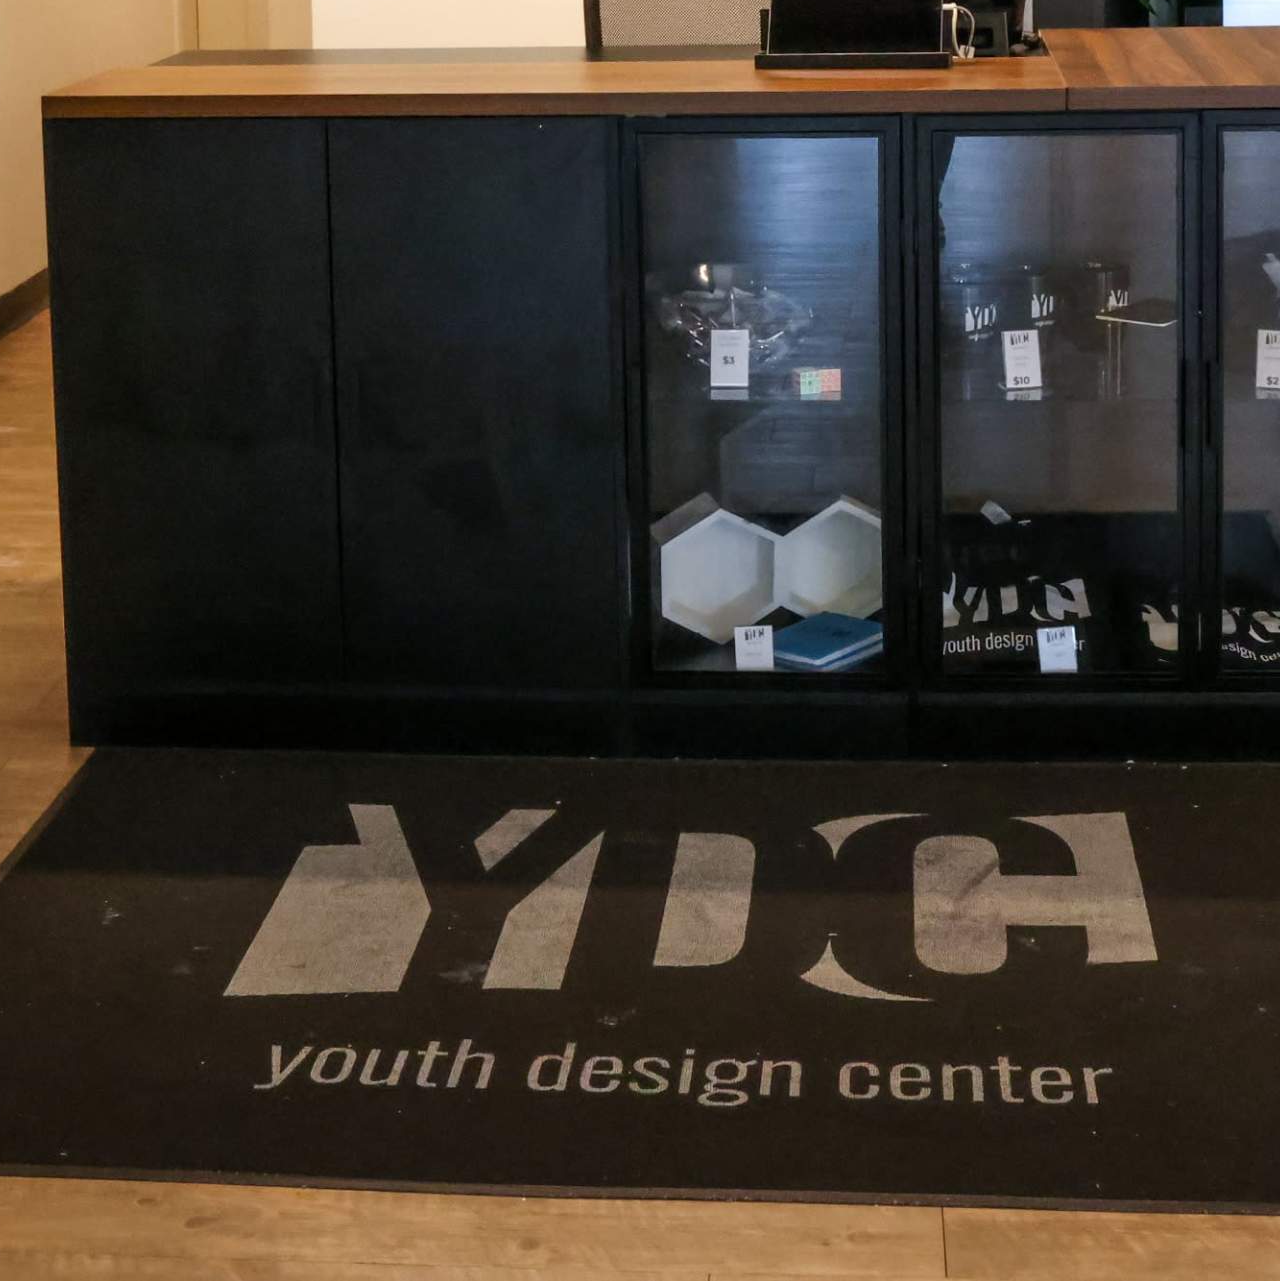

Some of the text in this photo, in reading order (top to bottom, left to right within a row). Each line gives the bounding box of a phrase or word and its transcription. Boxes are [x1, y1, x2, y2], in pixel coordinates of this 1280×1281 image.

[722, 355, 736, 366] $3
[1012, 376, 1031, 386] $10
[1265, 376, 1280, 386] $2
[985, 631, 1034, 651] design
[1222, 642, 1257, 661] sign
[254, 1037, 1114, 1107] youth design center
